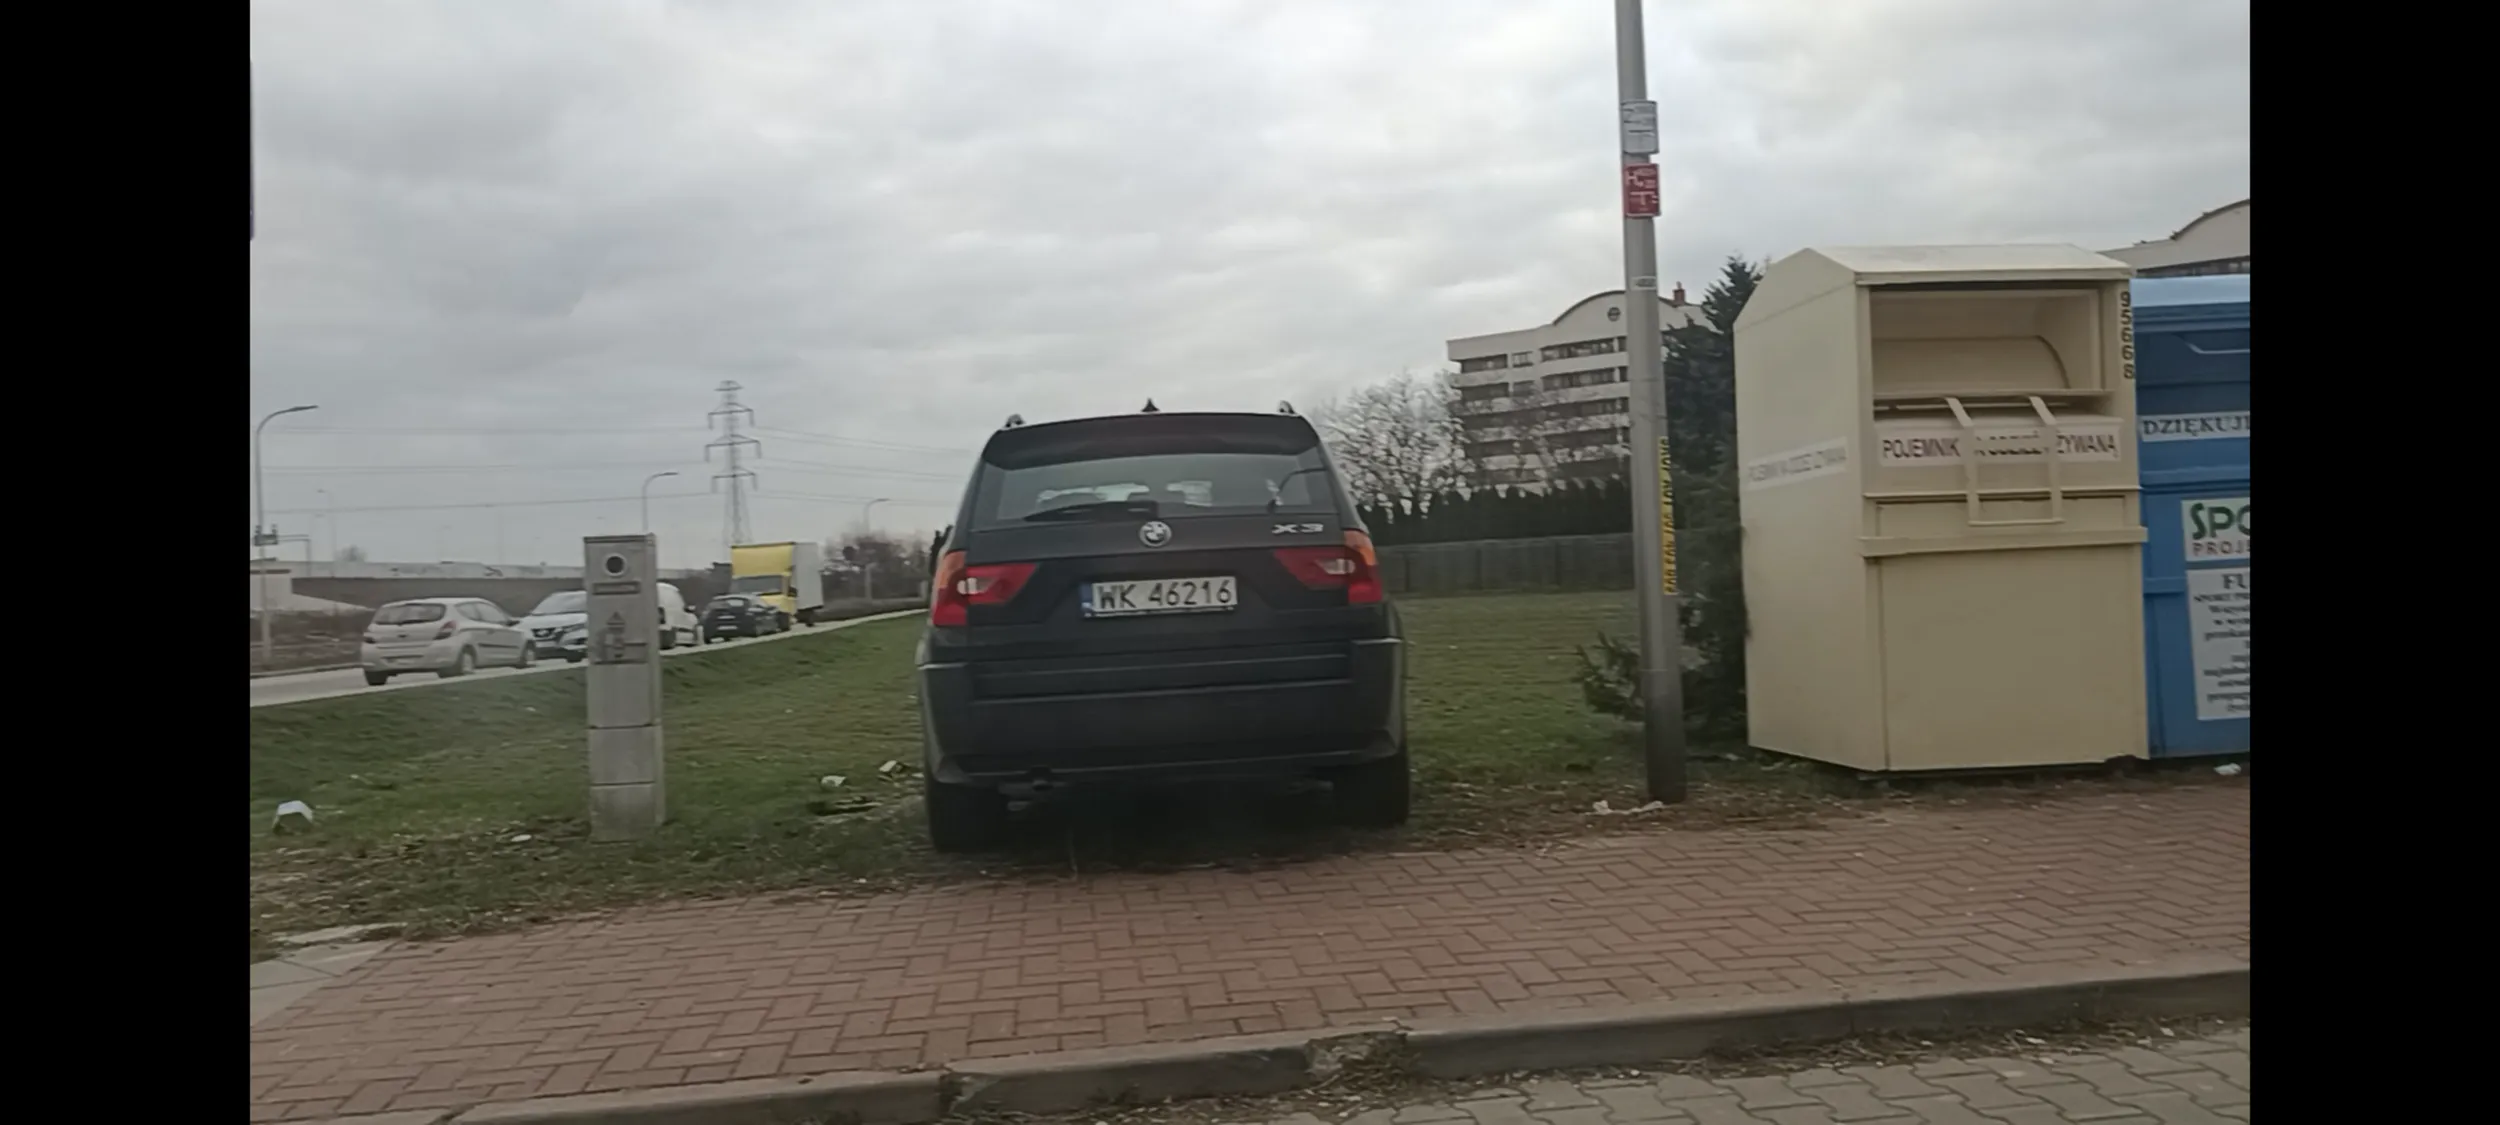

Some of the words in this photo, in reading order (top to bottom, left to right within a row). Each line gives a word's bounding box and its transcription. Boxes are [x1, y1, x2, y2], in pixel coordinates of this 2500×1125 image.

[1882, 437, 1961, 458] POJEMNIK
[1271, 522, 1324, 534] X3
[1097, 583, 1137, 609] WK
[1148, 578, 1232, 606] 46216
